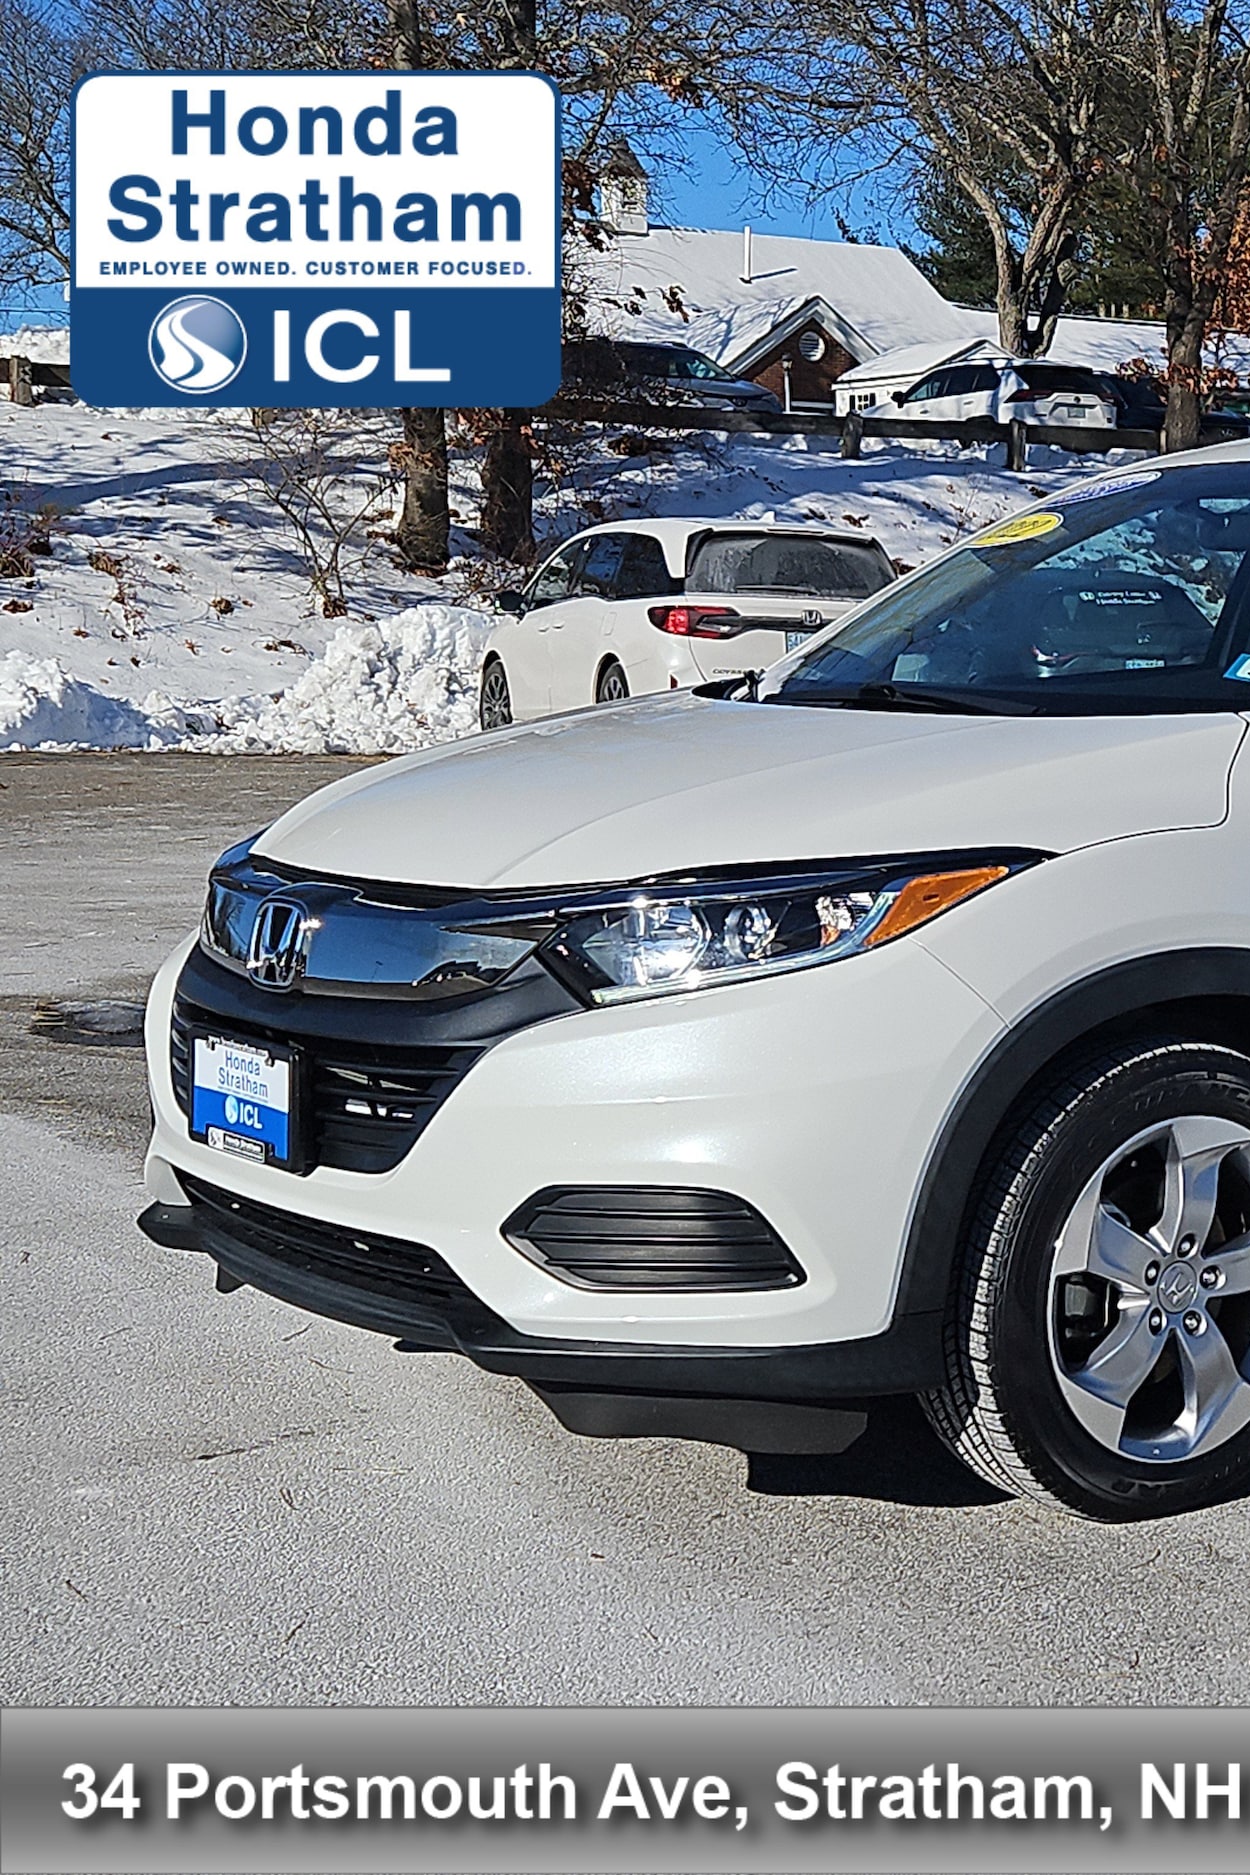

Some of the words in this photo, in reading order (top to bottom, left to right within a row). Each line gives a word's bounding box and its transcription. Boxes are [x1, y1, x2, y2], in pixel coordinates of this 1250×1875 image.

[225, 1049, 261, 1076] Honda
[218, 1066, 269, 1098] Stratham
[240, 1102, 263, 1130] ICL
